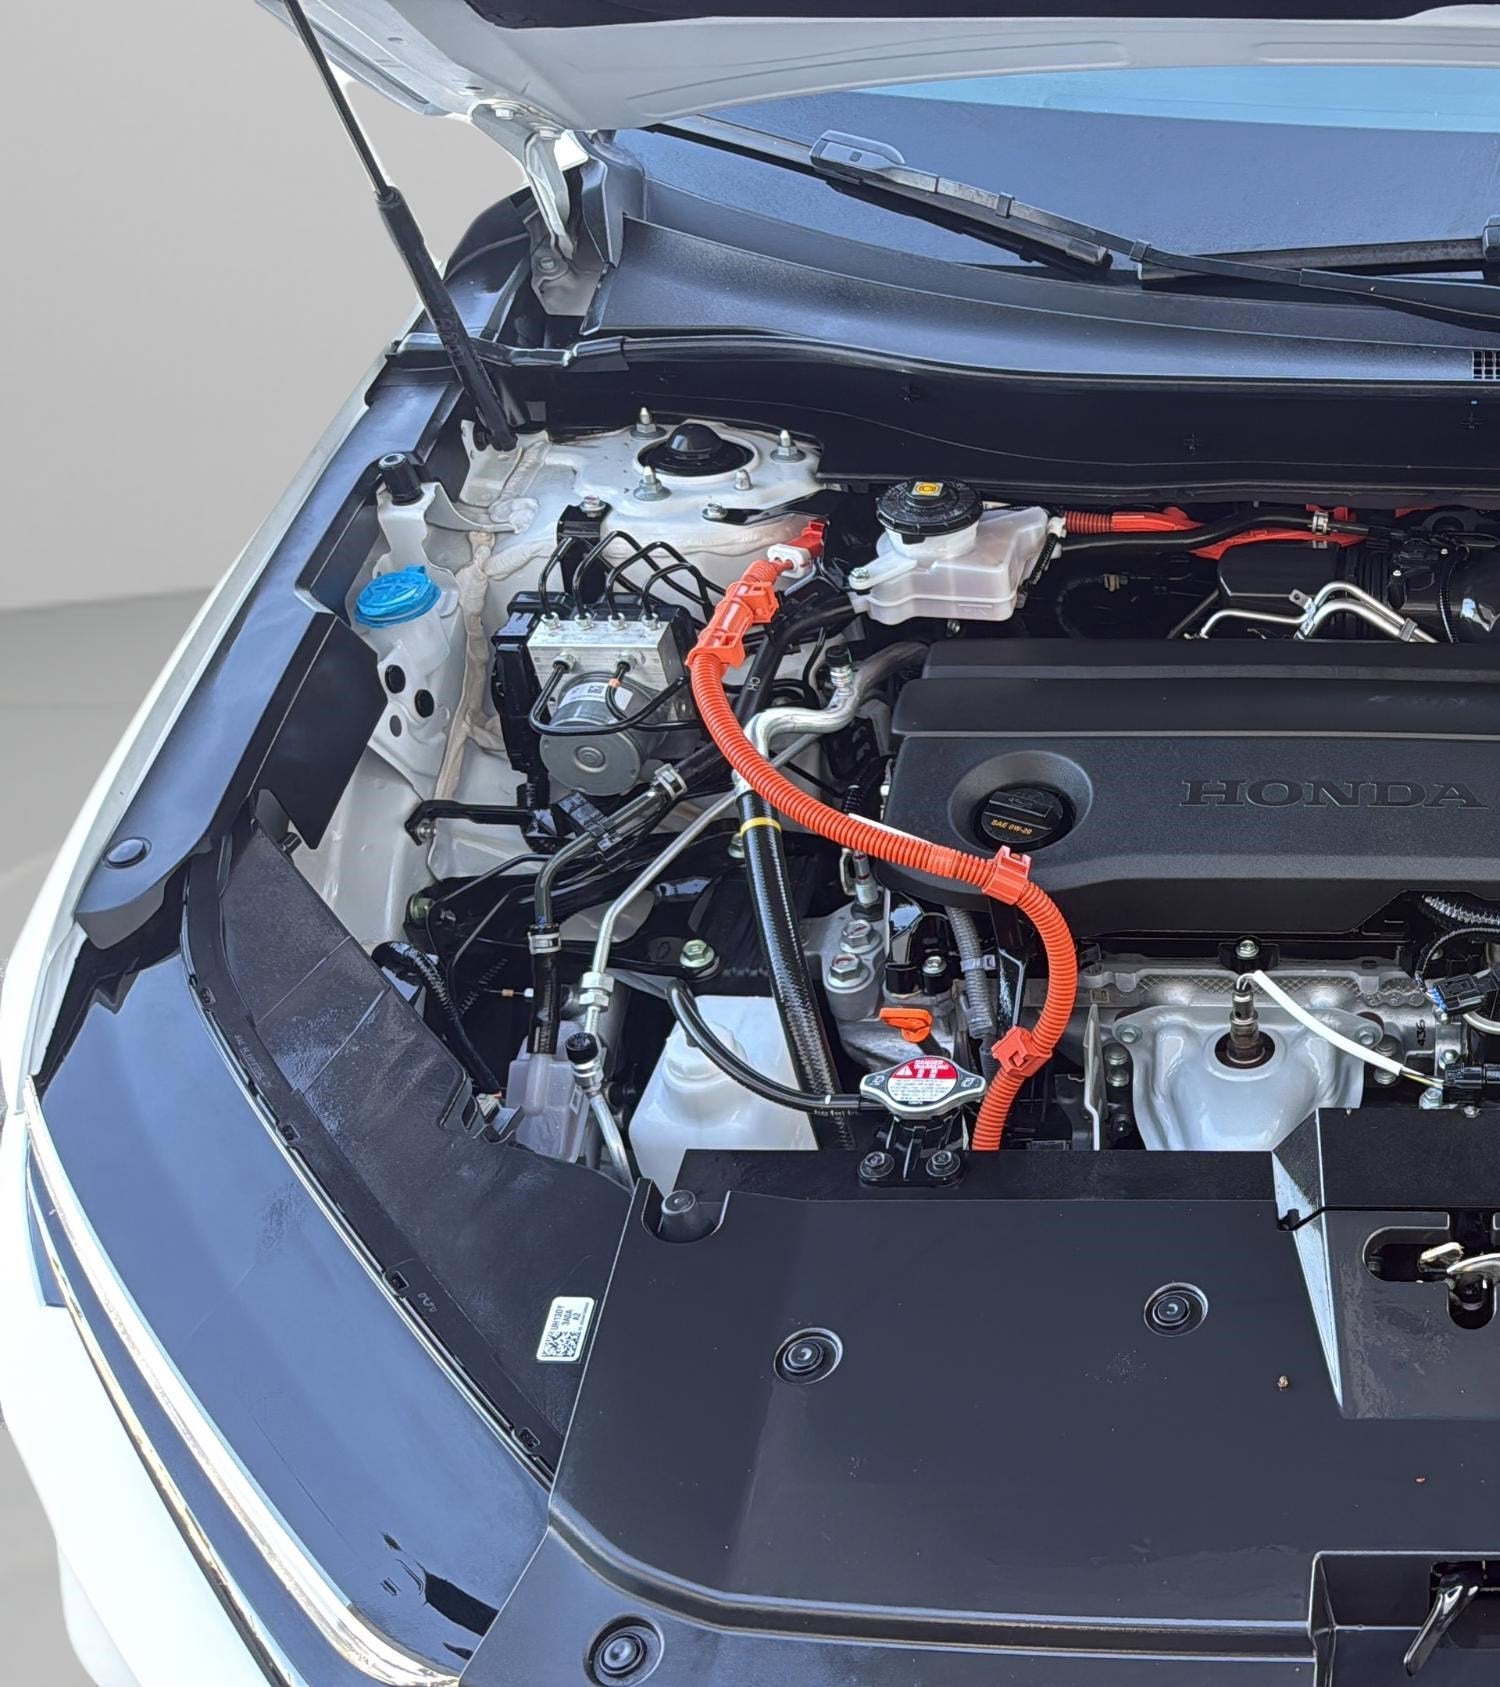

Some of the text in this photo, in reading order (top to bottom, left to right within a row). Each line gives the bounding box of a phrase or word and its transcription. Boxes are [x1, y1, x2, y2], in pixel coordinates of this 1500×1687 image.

[1179, 780, 1489, 810] HONDA
[991, 819, 1033, 836] SAE 0W-20
[1416, 1019, 1426, 1046] 436
